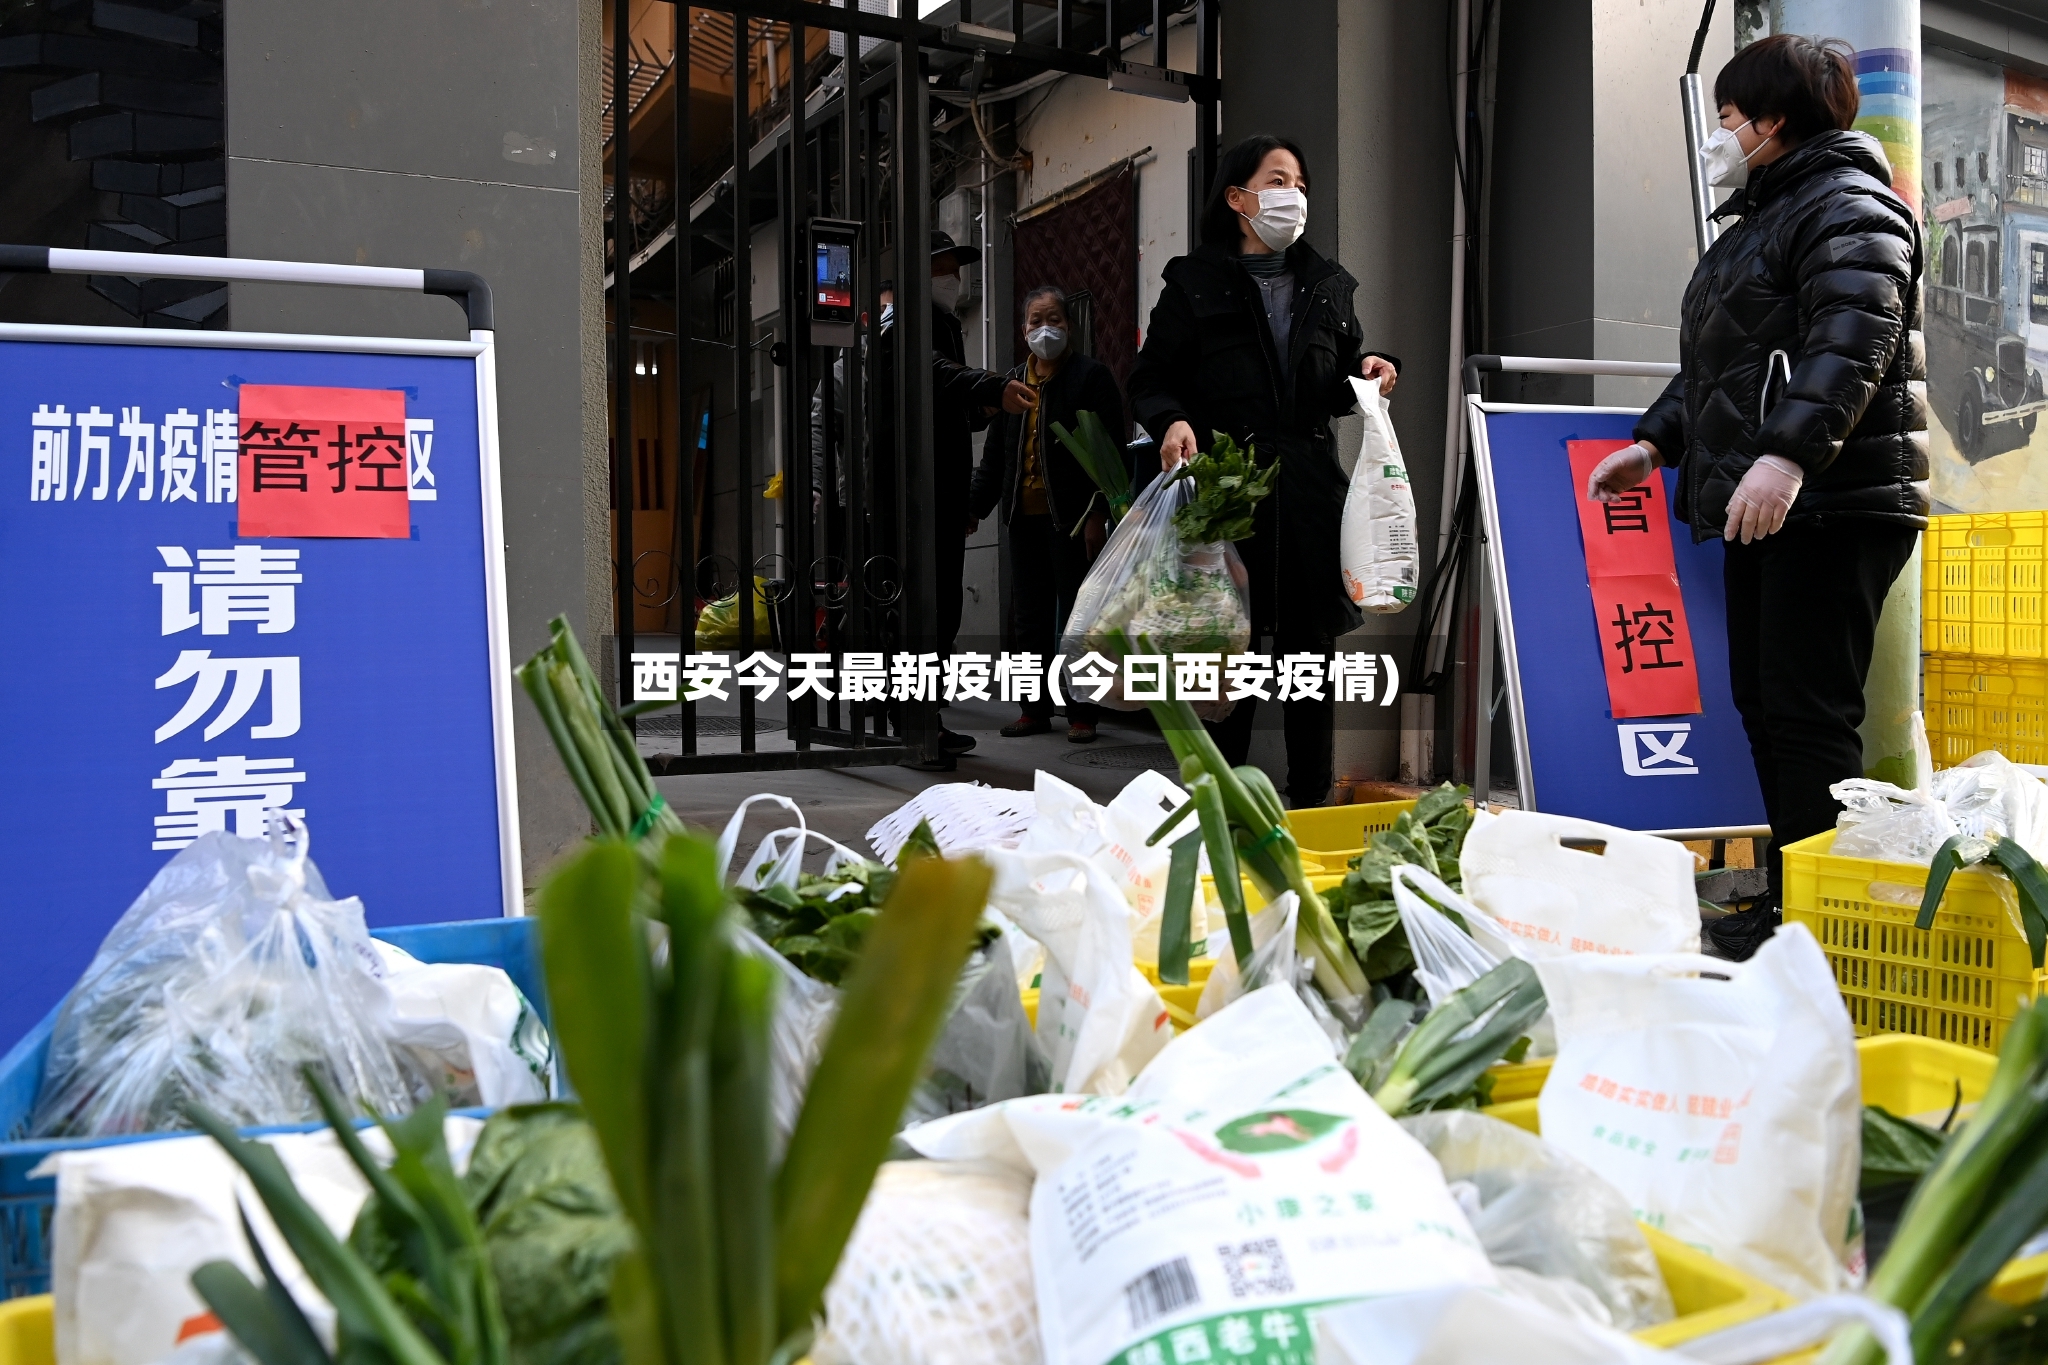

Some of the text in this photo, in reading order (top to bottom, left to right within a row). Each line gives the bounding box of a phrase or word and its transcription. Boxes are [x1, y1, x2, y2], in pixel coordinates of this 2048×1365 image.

[152, 545, 306, 851] 请勿靠
[1126, 1308, 1318, 1365] 陕西老牛
